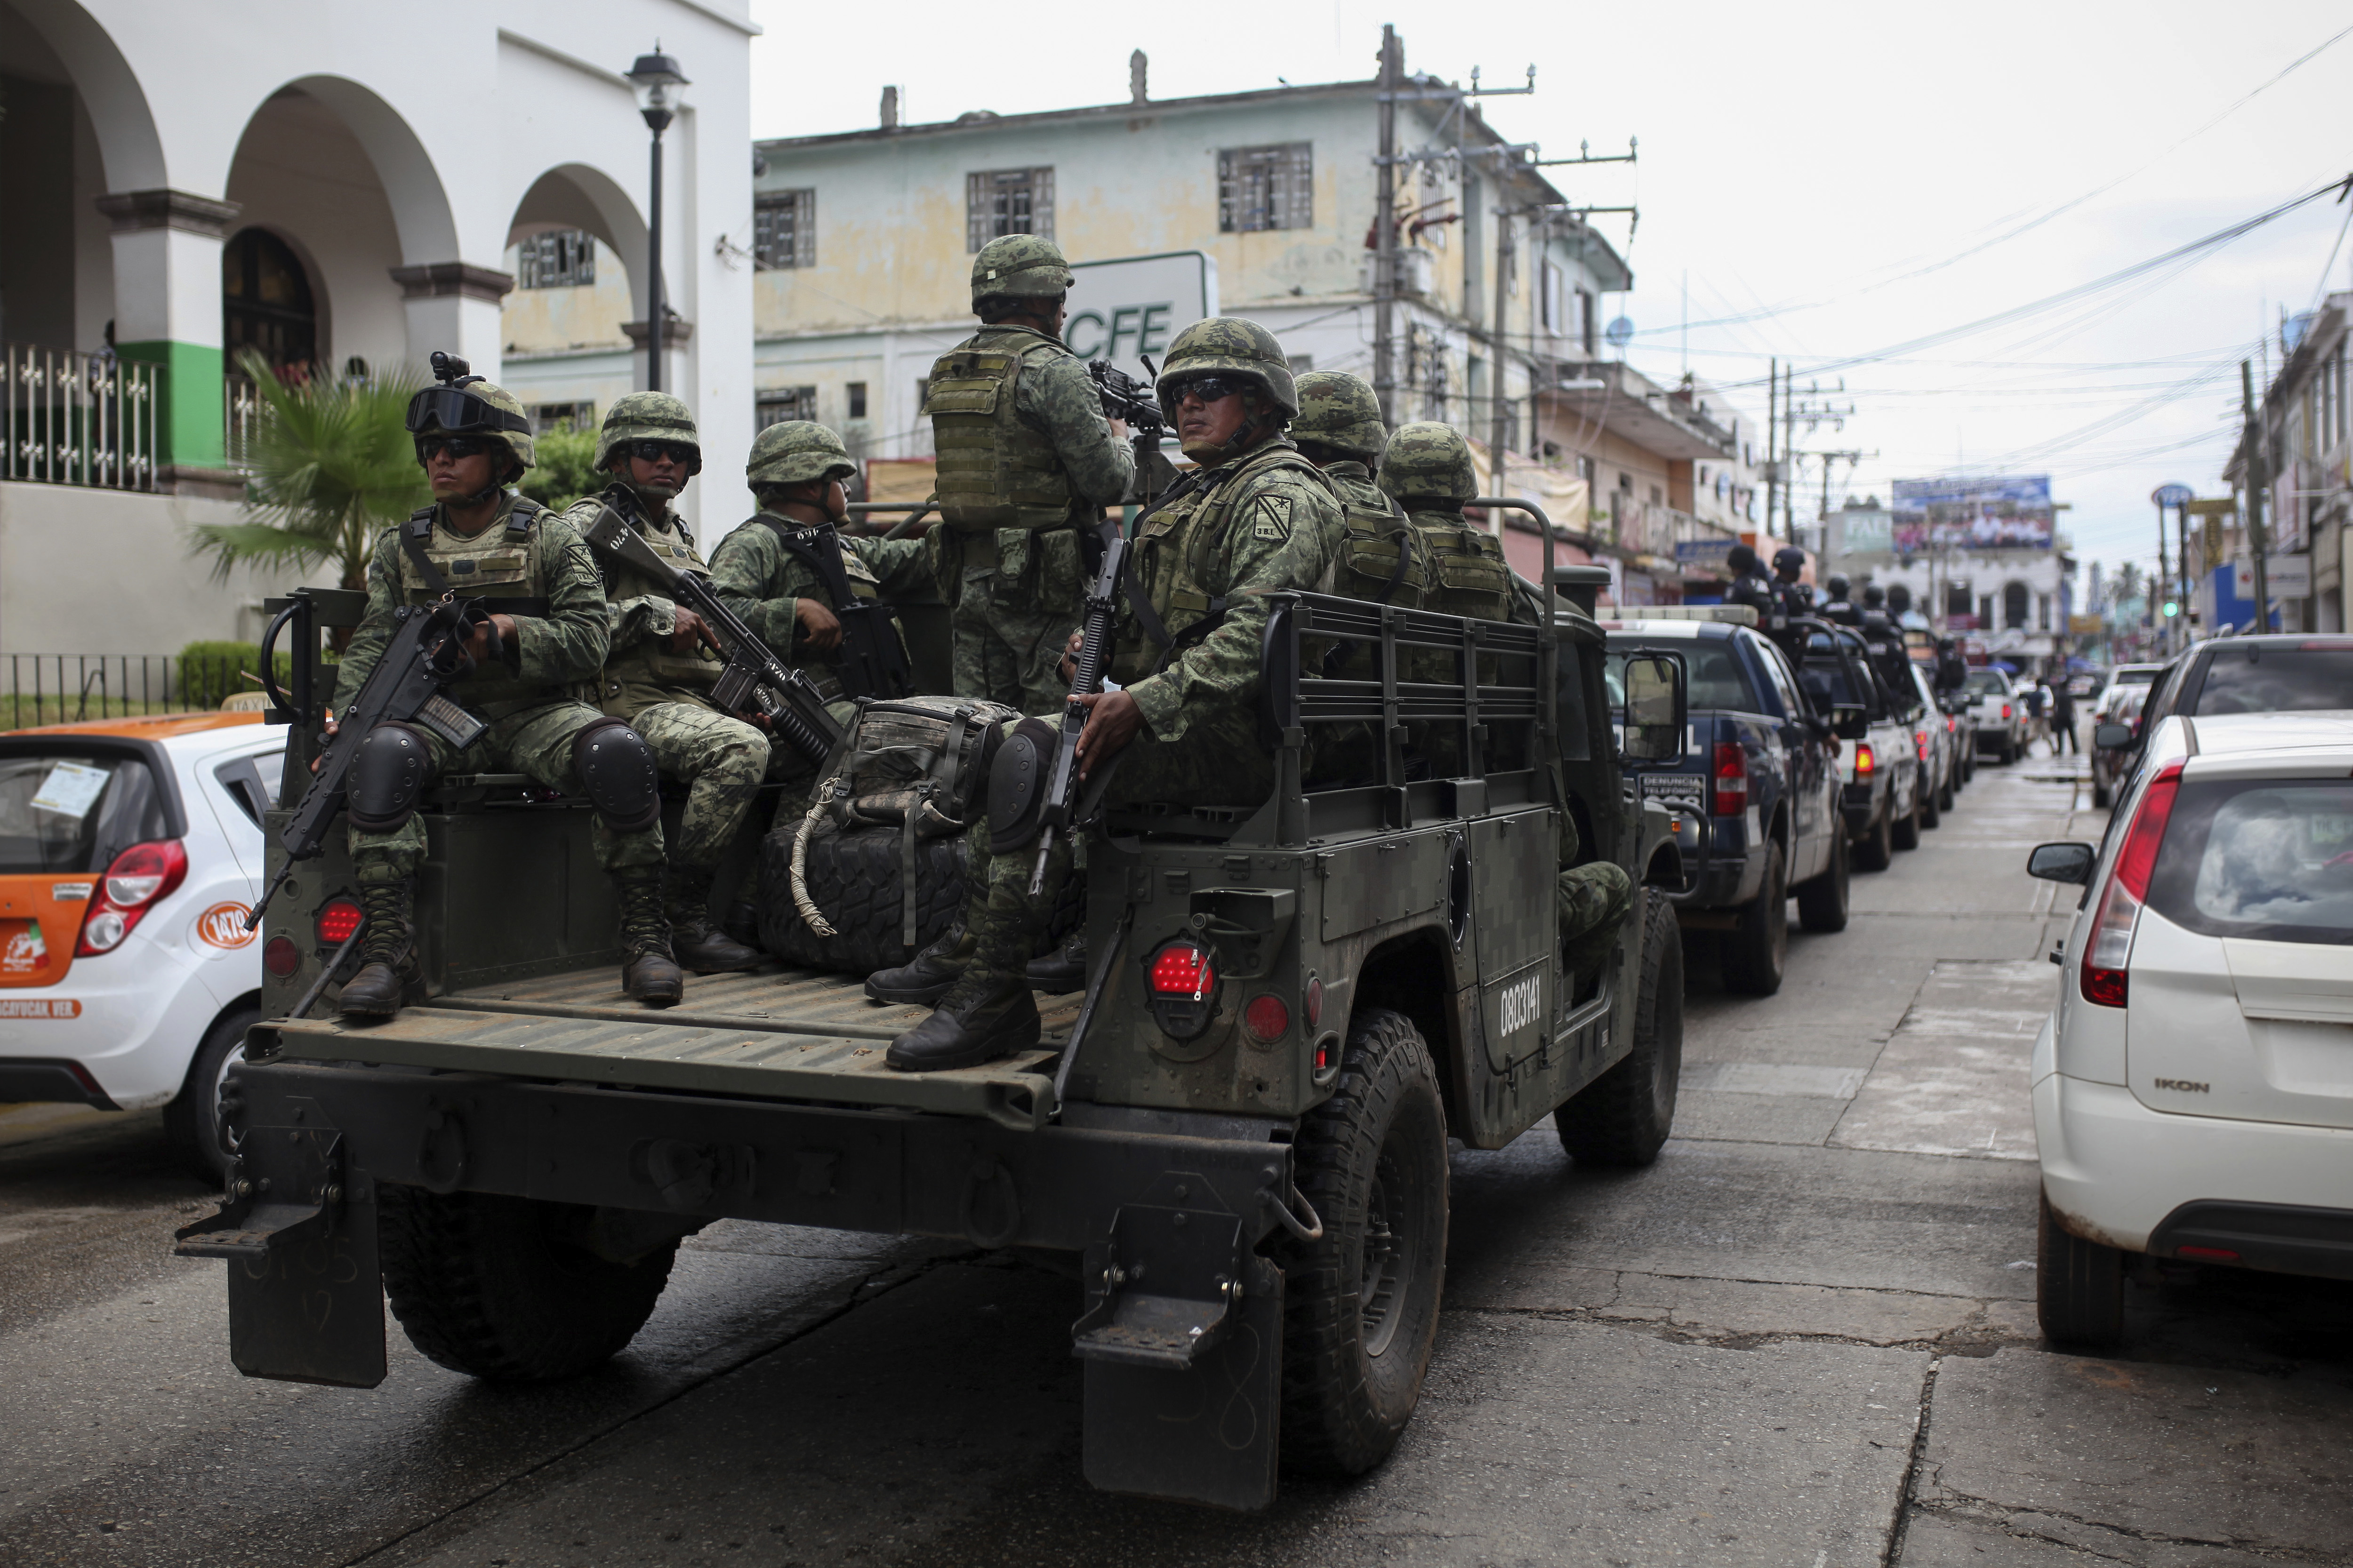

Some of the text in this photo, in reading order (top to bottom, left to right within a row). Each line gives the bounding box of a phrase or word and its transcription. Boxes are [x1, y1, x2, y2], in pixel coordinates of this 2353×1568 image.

[1065, 302, 1174, 360] CFE
[1643, 777, 1701, 787] DENUNCIA
[209, 909, 249, 942] 1479
[53, 1001, 76, 1017] VER.
[1501, 974, 1540, 1037] 0803141
[2155, 1077, 2209, 1093] IKON
